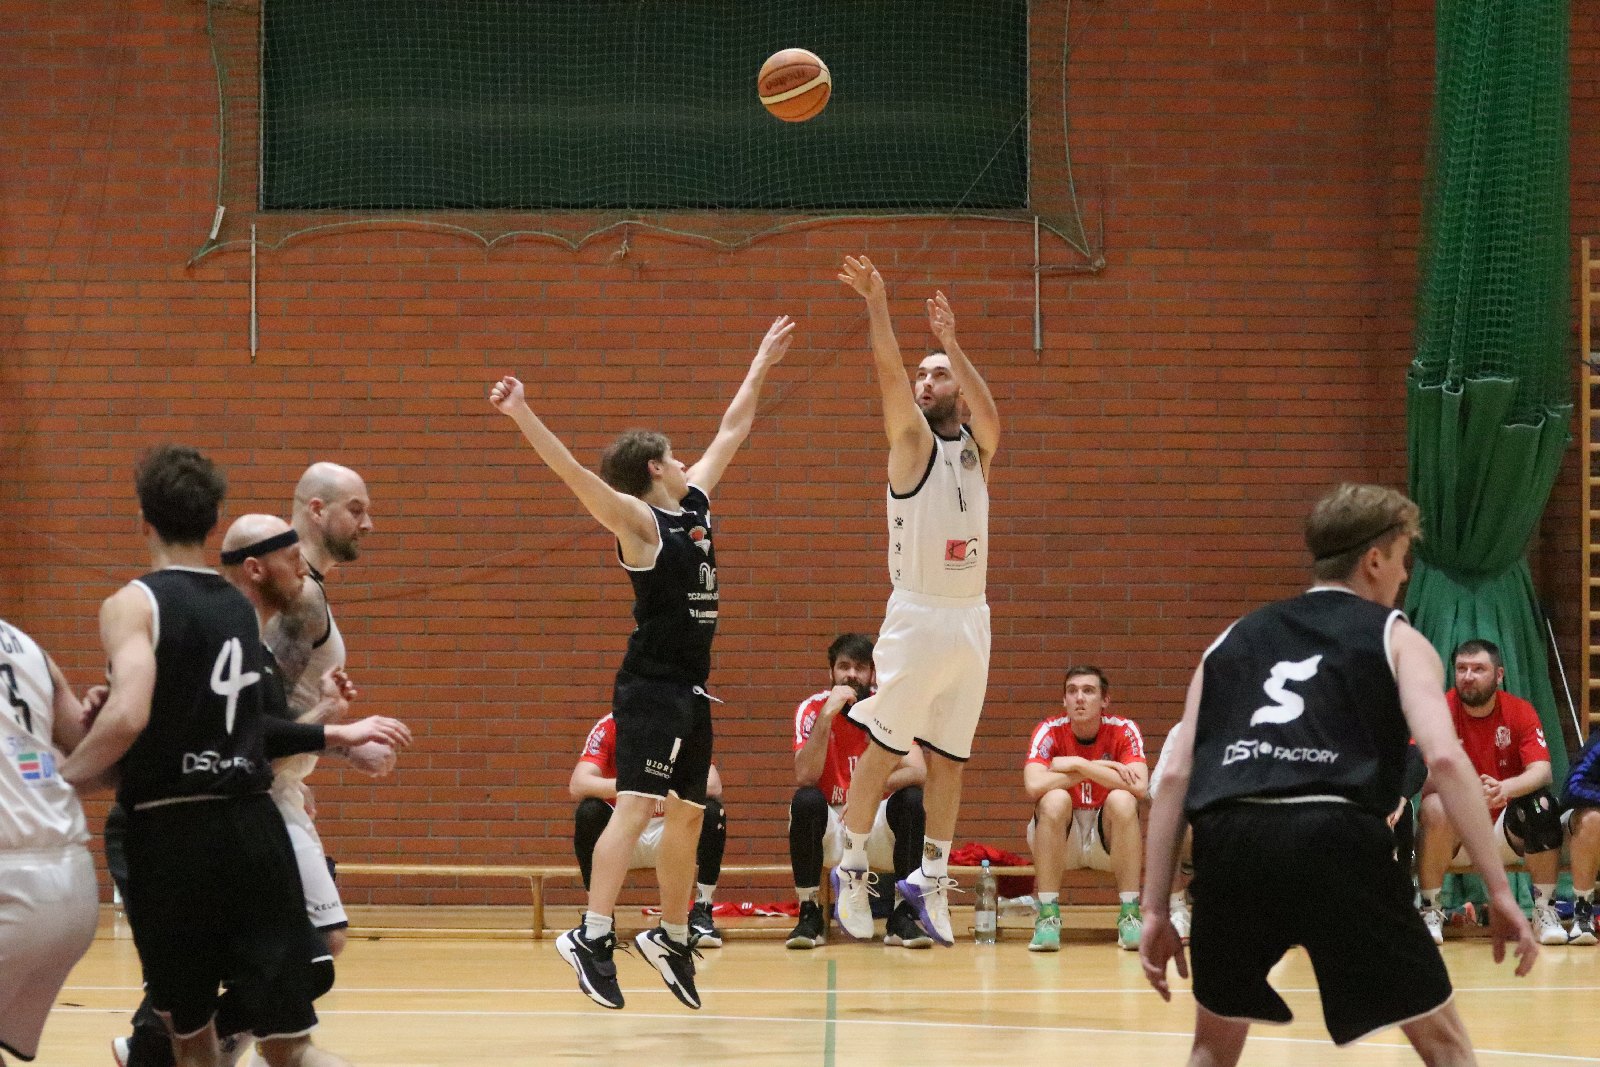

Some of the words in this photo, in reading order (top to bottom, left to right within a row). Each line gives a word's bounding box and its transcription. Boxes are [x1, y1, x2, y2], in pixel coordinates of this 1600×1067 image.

[210, 637, 261, 735] 4
[1273, 746, 1339, 763] FACTORY
[1081, 782, 1093, 804] 13
